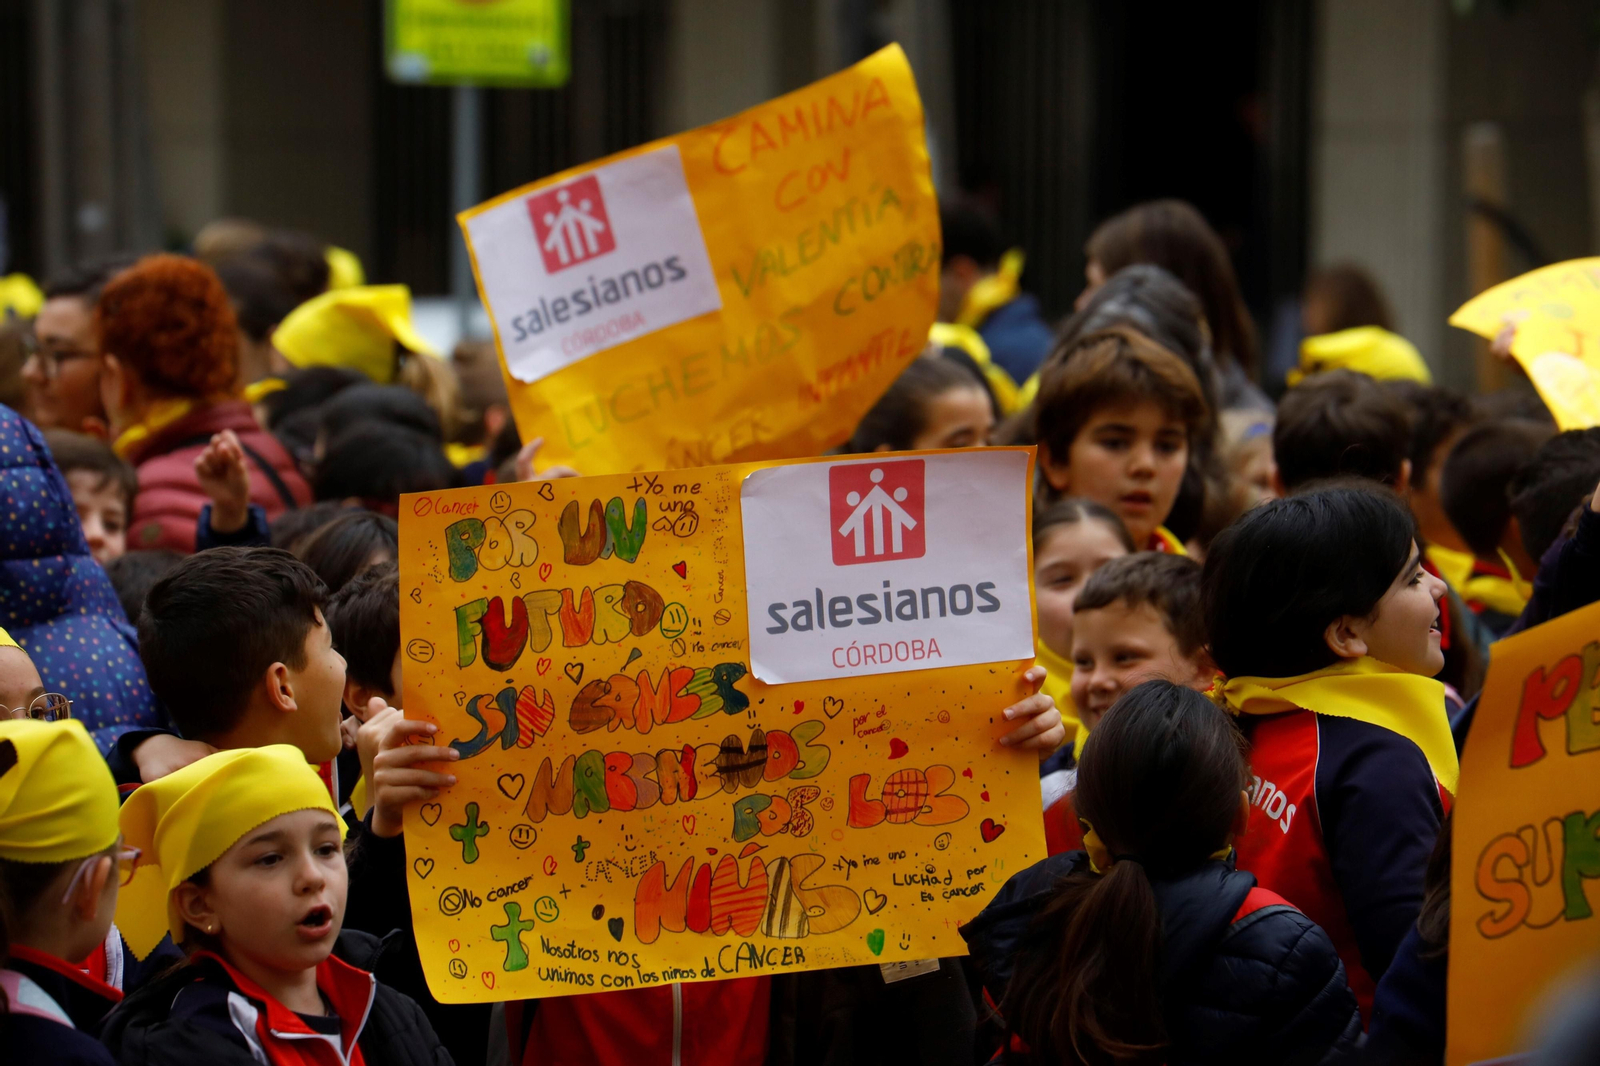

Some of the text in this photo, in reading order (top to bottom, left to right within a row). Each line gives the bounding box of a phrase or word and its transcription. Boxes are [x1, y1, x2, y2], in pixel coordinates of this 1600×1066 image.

[711, 77, 894, 177] CAMINA
[774, 147, 851, 213] CON
[512, 255, 687, 343] salesianos
[560, 307, 806, 452] LUCHEMOS
[673, 483, 701, 495] me
[445, 496, 647, 583] POR UN
[453, 580, 666, 672] FUTURO
[765, 580, 1001, 635] salesianos
[831, 638, 942, 669] CÓRDOBA
[448, 678, 556, 761] SIN
[522, 719, 832, 824] MARCHEMOS
[847, 764, 970, 829] LOS
[863, 855, 880, 866] me
[966, 865, 987, 879] por
[463, 888, 482, 909] No
[540, 935, 641, 969] Nosotros nos
[601, 973, 634, 988] con
[637, 969, 659, 984] los
[701, 957, 716, 978] de
[717, 942, 806, 974] CANCER
